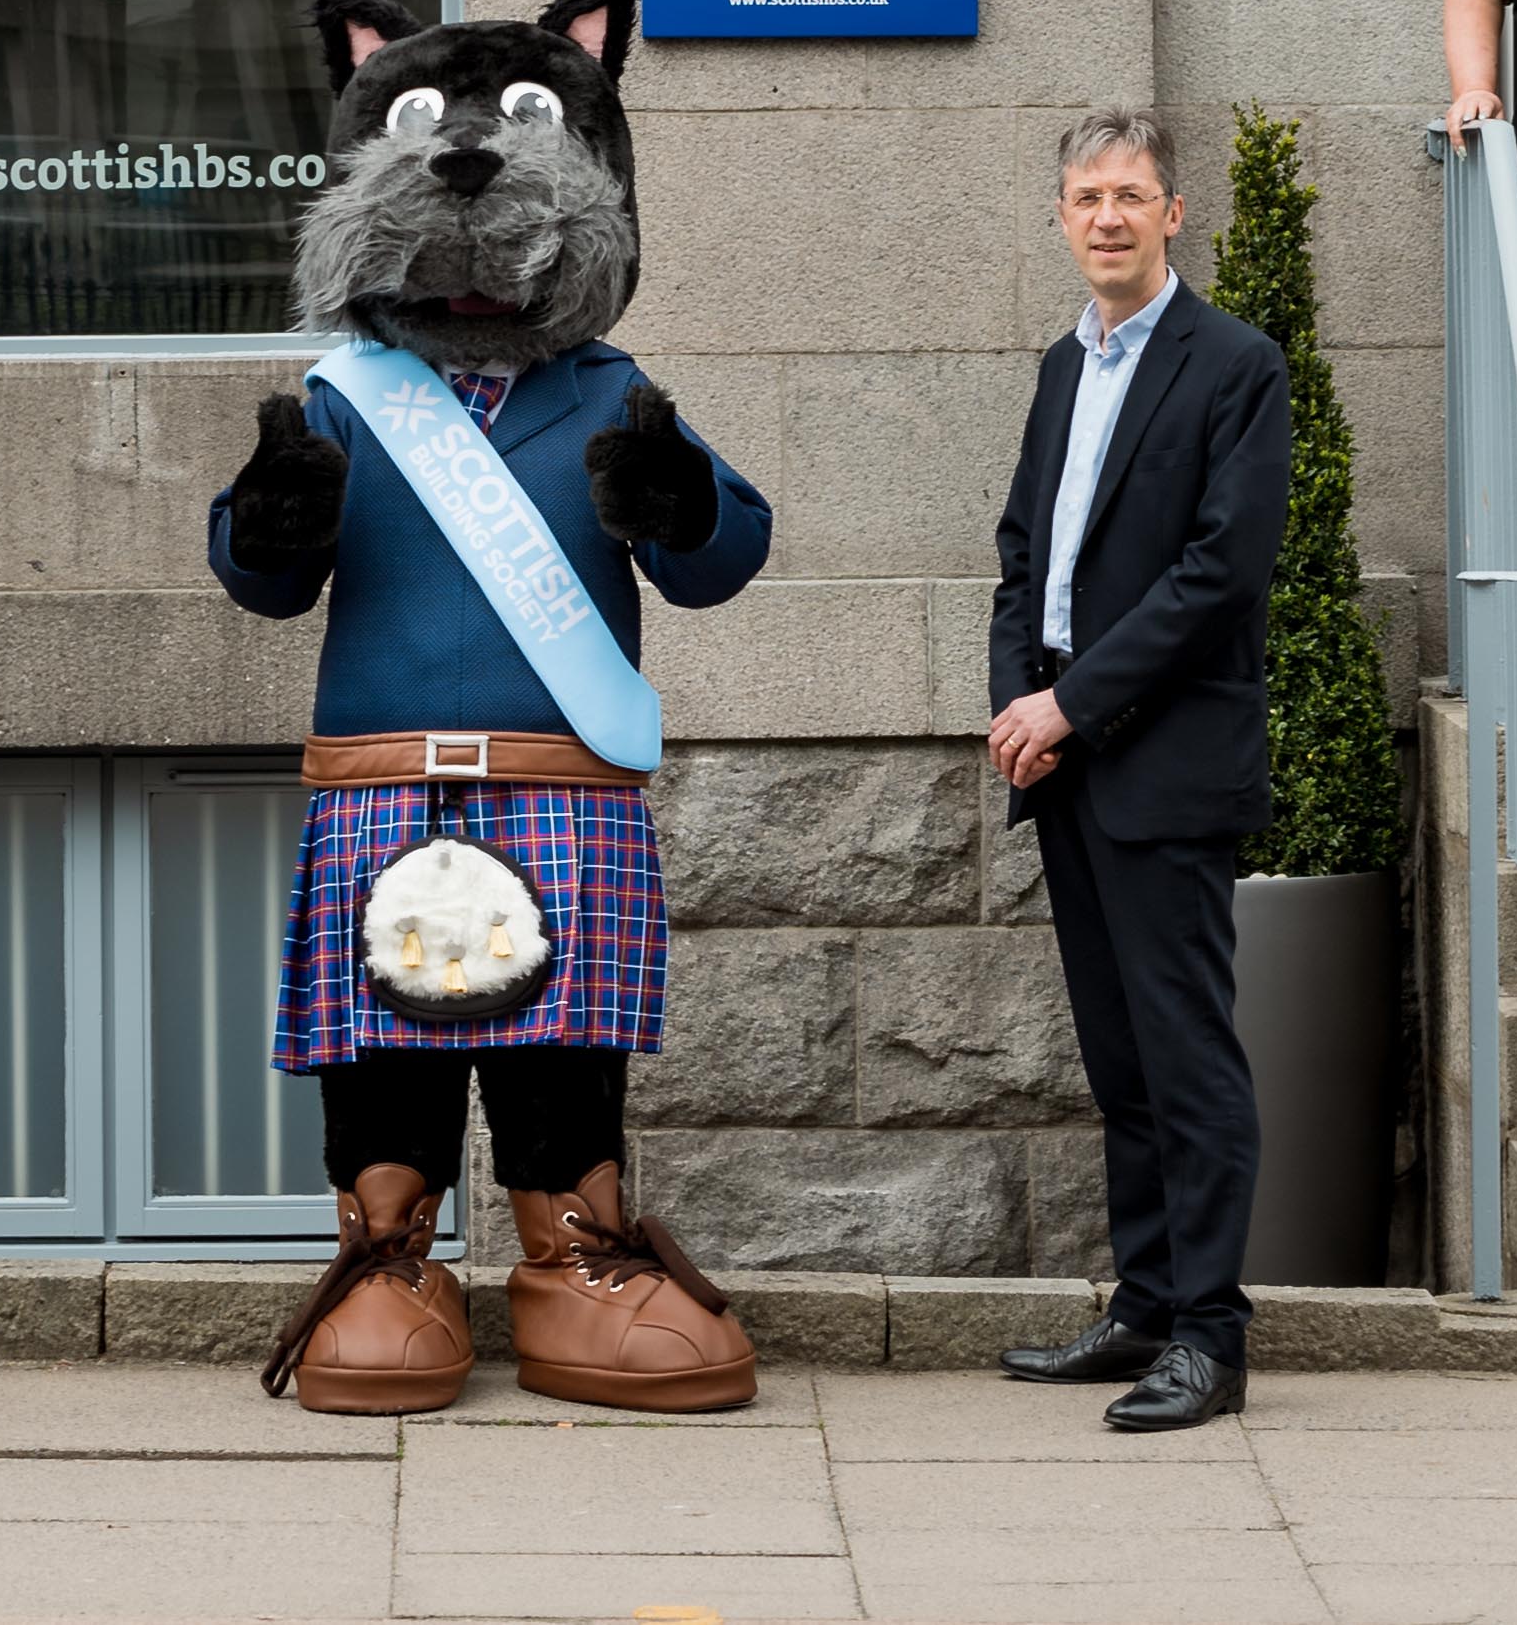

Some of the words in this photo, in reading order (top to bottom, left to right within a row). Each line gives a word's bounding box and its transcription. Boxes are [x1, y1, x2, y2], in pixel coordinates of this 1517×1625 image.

[407, 442, 490, 550] BUILDING
[482, 547, 561, 644] SOCIETY
[431, 423, 591, 633] SCOTTISH
